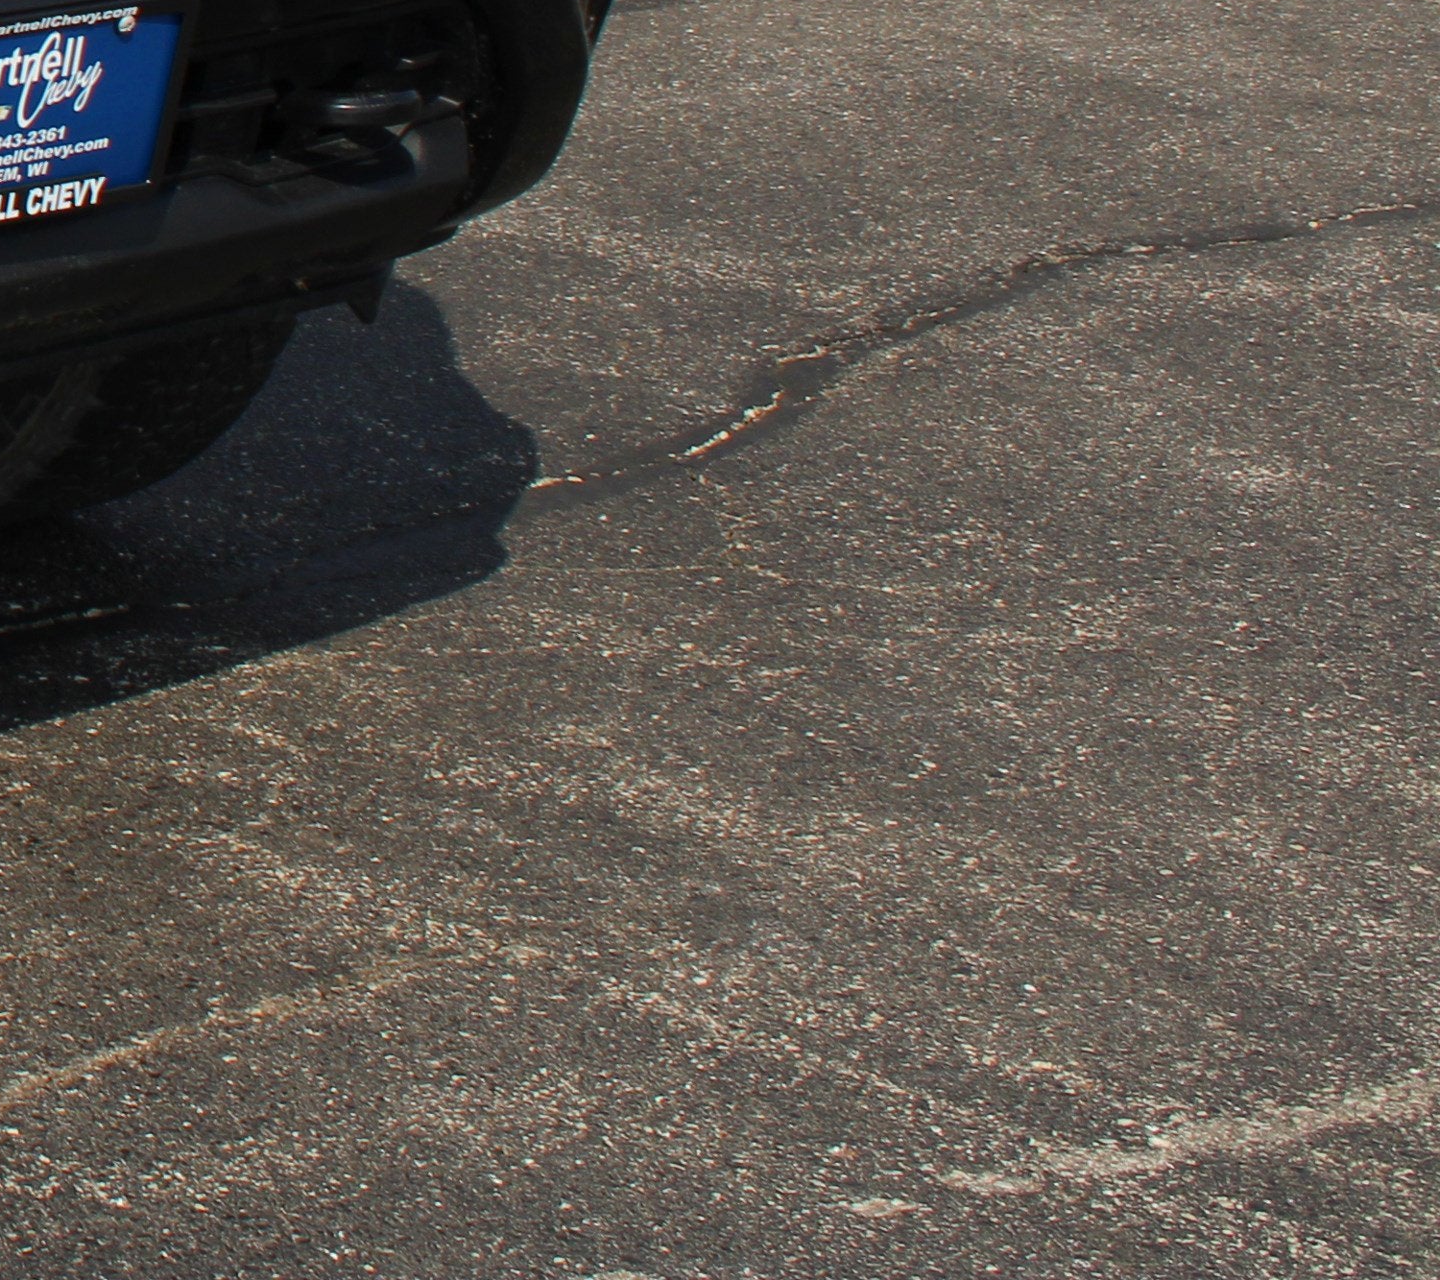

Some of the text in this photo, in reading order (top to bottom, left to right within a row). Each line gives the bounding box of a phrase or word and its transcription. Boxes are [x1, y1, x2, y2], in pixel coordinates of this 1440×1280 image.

[16, 31, 103, 129] Chevy
[27, 160, 50, 178] WI
[25, 176, 106, 216] CHEVY
